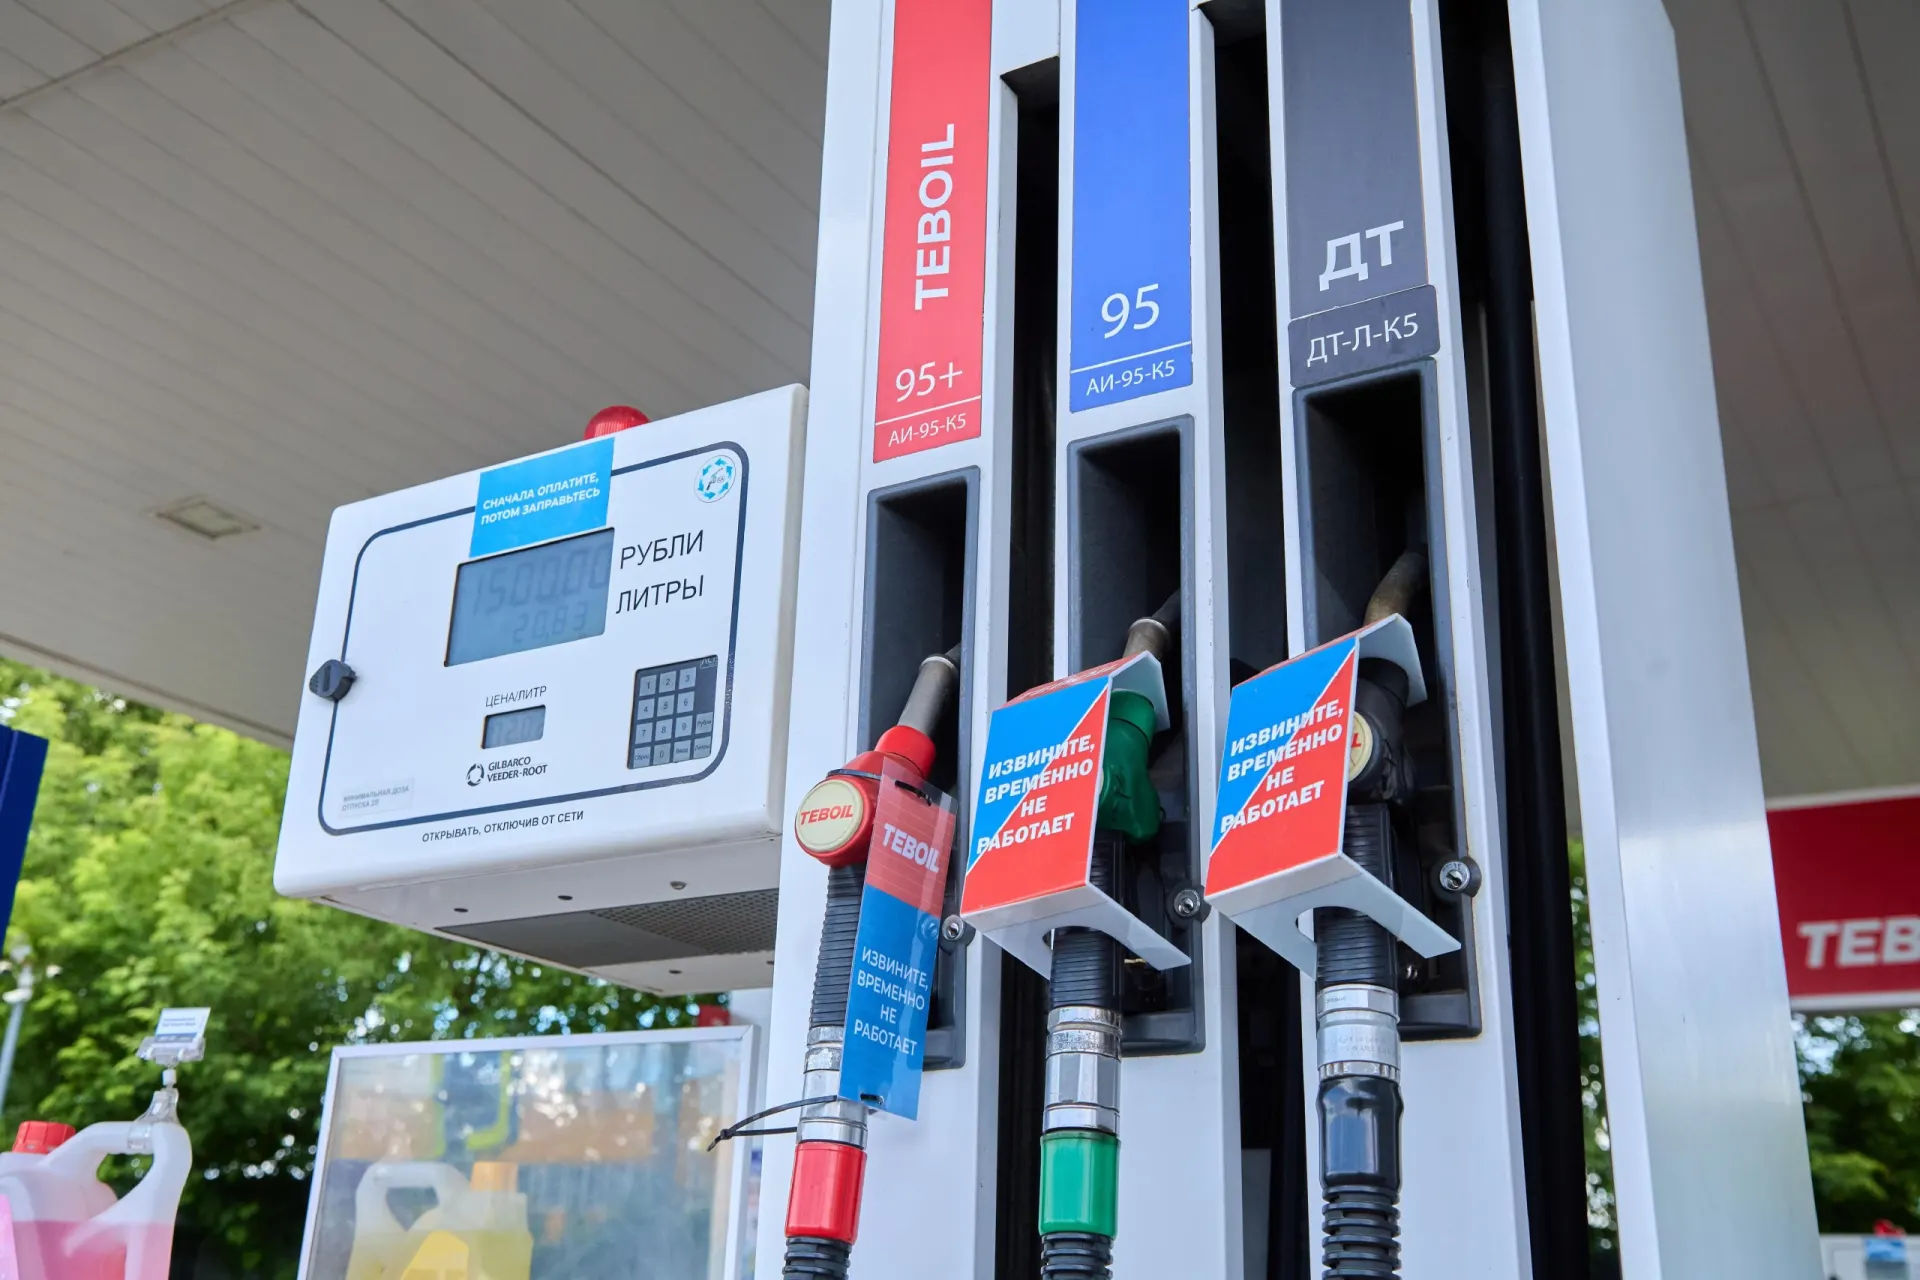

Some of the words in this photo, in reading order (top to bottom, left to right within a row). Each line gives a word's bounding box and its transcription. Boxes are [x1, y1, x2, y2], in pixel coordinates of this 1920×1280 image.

[914, 123, 955, 310] TEBOIL
[1319, 220, 1404, 291] ДТ
[1101, 283, 1160, 339] 95
[1307, 312, 1419, 368] ДТ-Л-К5
[895, 361, 963, 402] 95+
[1086, 359, 1175, 396] АИ-95-К5
[888, 413, 967, 446] АИ-95-К5
[481, 506, 520, 525] ПОТОМ
[521, 487, 601, 515] ЗАПРАВЬТЕСЬ
[483, 488, 535, 510] СНАЧАЛА
[537, 472, 600, 497] ОПЛАТИТЕ,
[620, 529, 704, 570] РУБЛИ
[615, 575, 704, 615] ЛИТРЫ
[485, 685, 547, 708] ЦЕНА/ЛИТР
[1230, 699, 1344, 757] ИЗВИНИТЕ,
[487, 764, 548, 782] VEEDER-ROOT
[488, 756, 531, 771] GILBARCO
[988, 734, 1095, 780] ИЗВИНИТЕ,
[1227, 724, 1343, 782] ВРЕМЕННО
[984, 758, 1094, 804] ВРЕМЕННО
[1266, 766, 1294, 792] НЕ
[422, 826, 482, 842] ОТКРЫВАТЬ,
[484, 817, 539, 834] ОТКЛЮЧИВ
[541, 814, 555, 825] ОТ
[557, 810, 584, 823] СЕТИ
[801, 805, 854, 825] TEBOIL
[1020, 796, 1047, 818] НЕ
[1220, 780, 1325, 834] РАБОТАЕТ
[882, 822, 940, 873] TEBOIL
[976, 812, 1075, 854] РАБОТАЕТ
[862, 946, 929, 991] ИЗВИНИТЕ,
[857, 970, 925, 1010] ВРЕМЕННО
[880, 1004, 897, 1024] НЕ
[854, 1019, 918, 1056] РАБОТАЕТ
